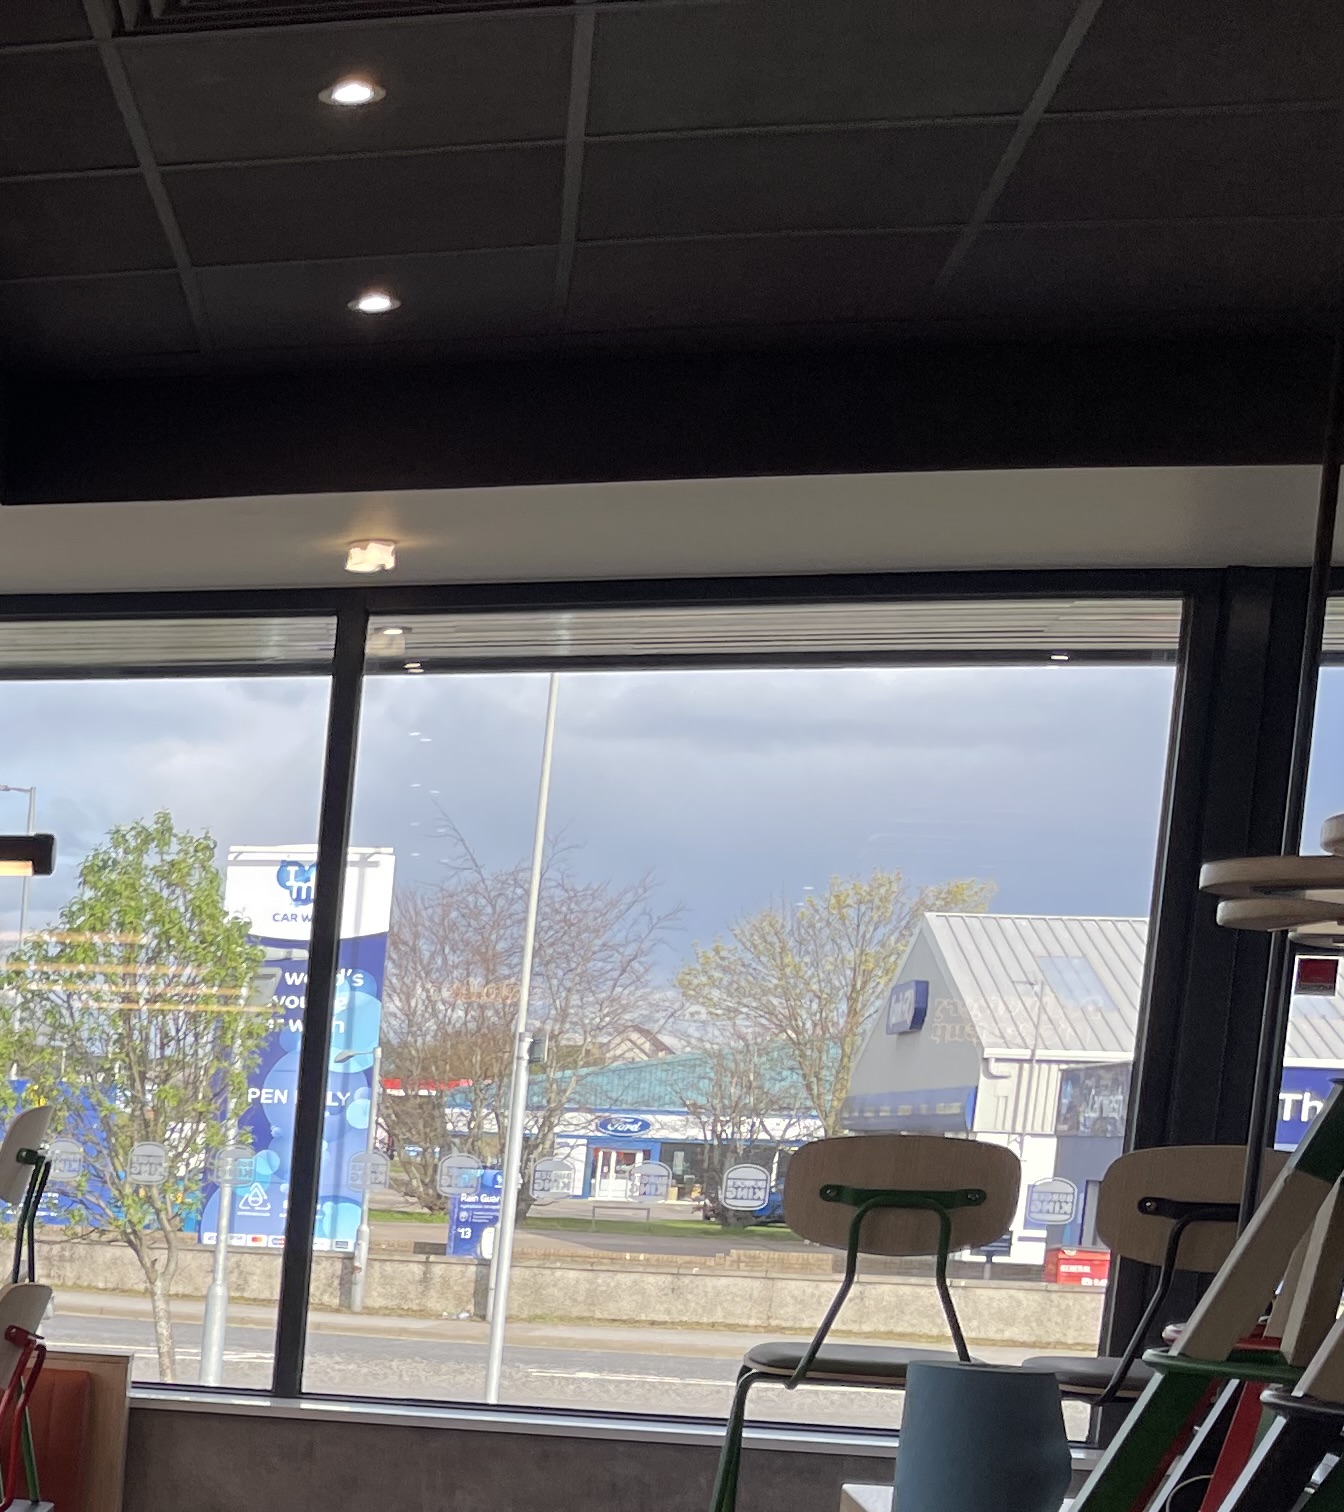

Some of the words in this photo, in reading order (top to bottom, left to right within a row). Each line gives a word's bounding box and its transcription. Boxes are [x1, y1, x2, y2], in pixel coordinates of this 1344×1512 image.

[272, 913, 298, 922] CAR
[247, 1087, 289, 1105] PEN
[606, 1117, 643, 1132] Ford
[480, 1195, 500, 1203] Guar
